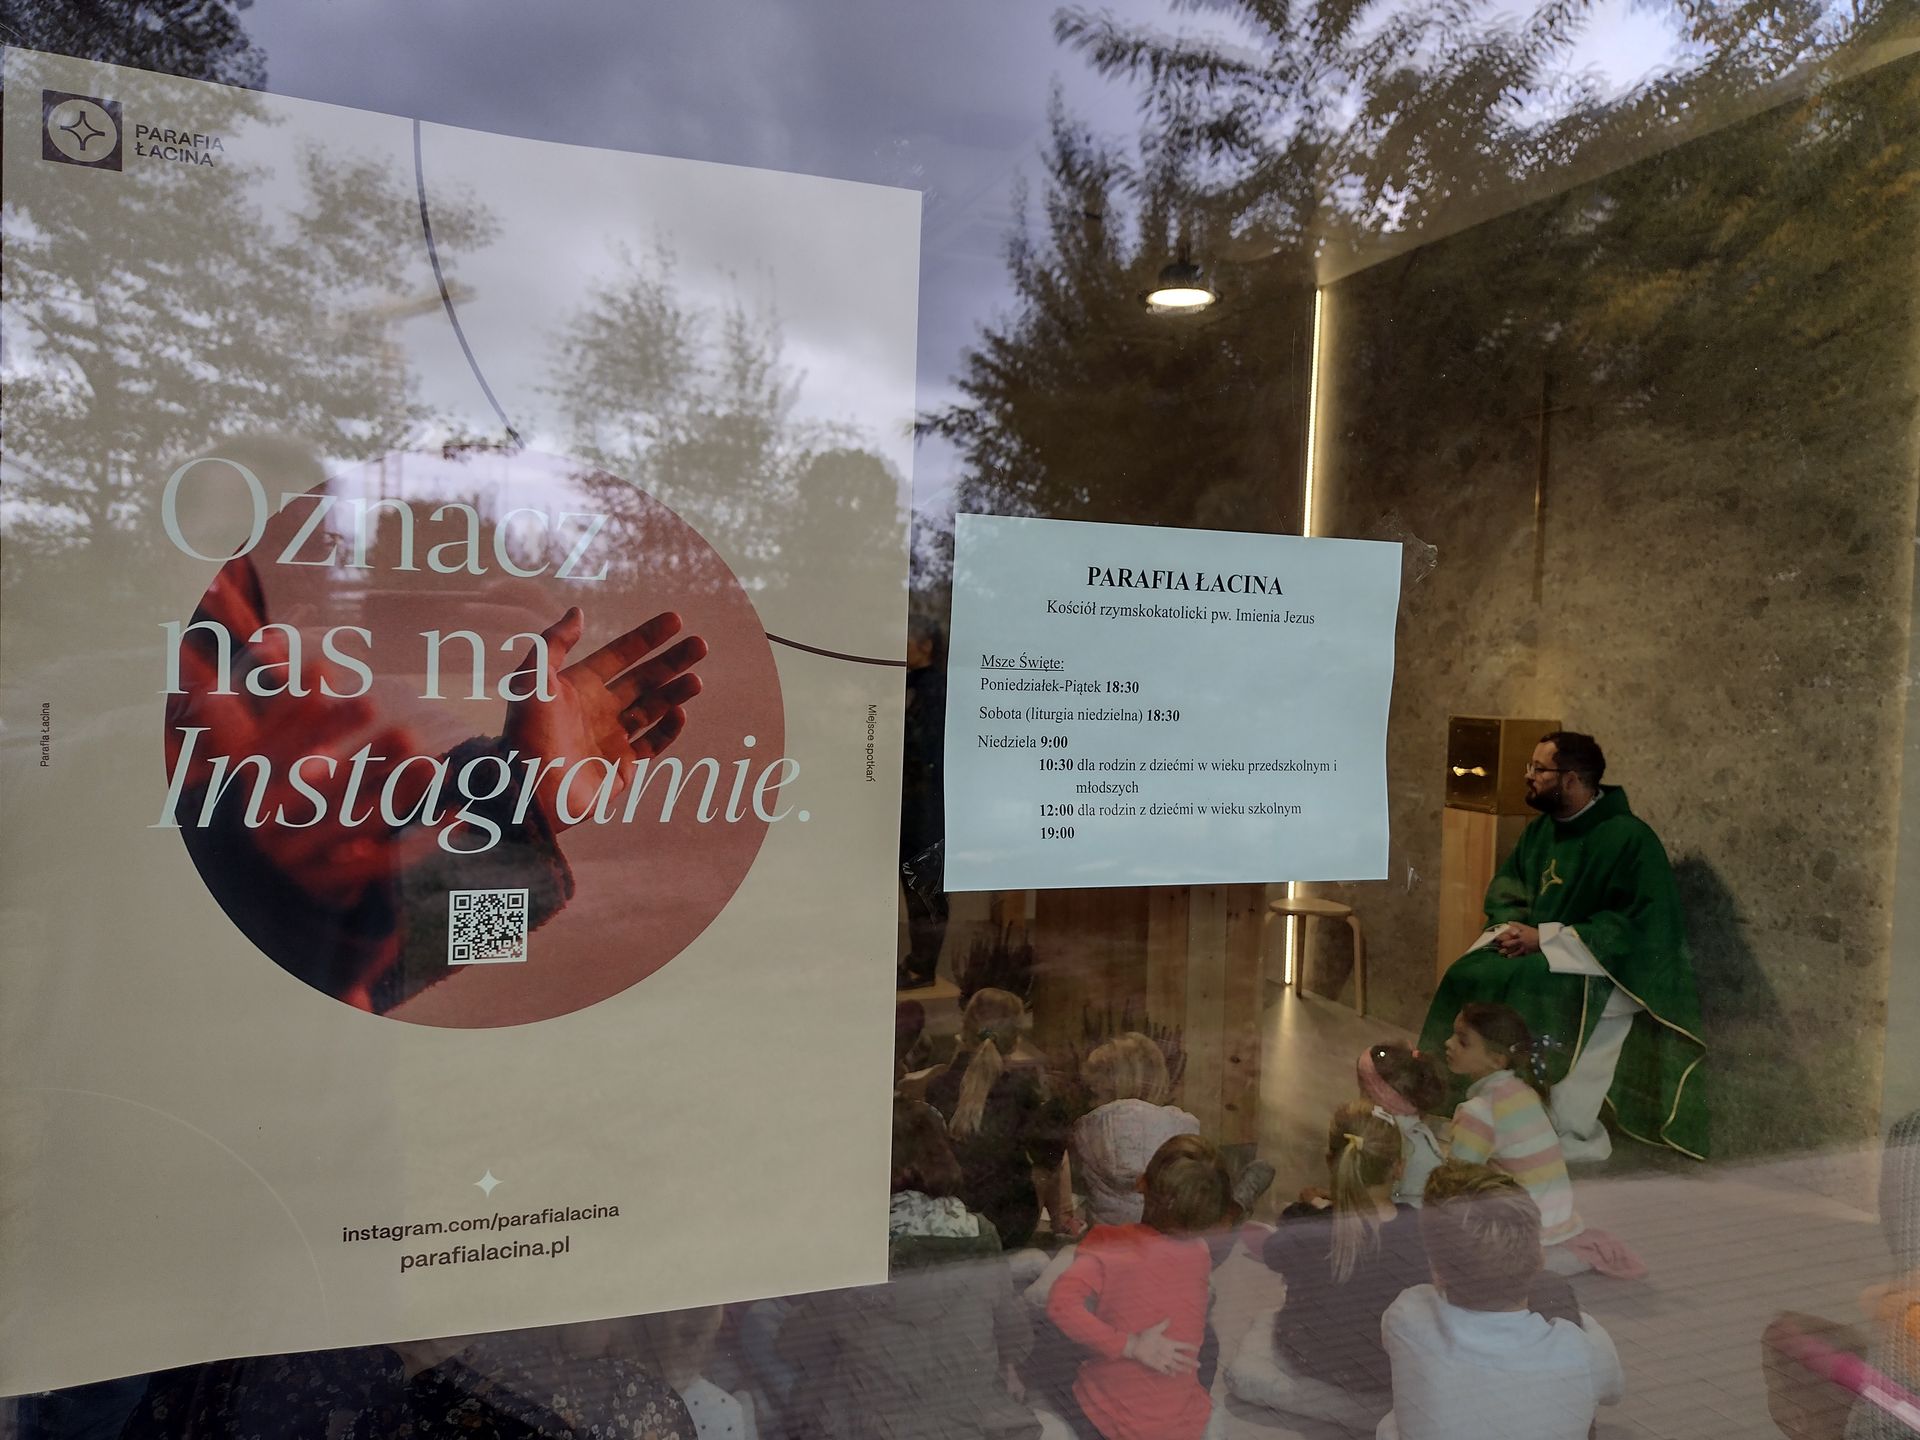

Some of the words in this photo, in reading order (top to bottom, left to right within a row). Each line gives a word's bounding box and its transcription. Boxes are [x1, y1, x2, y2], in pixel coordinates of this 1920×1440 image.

[135, 124, 225, 152] PARAFIA
[134, 141, 214, 167] ŁACINA
[161, 456, 612, 582] Oznacz
[1086, 566, 1190, 591] PARAFIA
[1195, 572, 1283, 595] ŁACINA
[1047, 600, 1096, 615] Kościół
[1100, 604, 1207, 622] rzymskokatolicki
[1211, 611, 1231, 623] pw.
[1236, 609, 1282, 623] Imienia
[1284, 611, 1314, 624] Jezus
[157, 614, 374, 699] nas
[418, 628, 558, 703] na
[980, 652, 1017, 671] Msze
[1018, 652, 1064, 672] Święte:
[981, 677, 1103, 696] Poniedziałek-Piątek
[1105, 681, 1140, 693] 18:30
[40, 702, 50, 733] Łacina
[866, 704, 877, 741] Miejsce
[979, 705, 1021, 720] Sobota
[1025, 705, 1074, 724] (liturgia
[1078, 706, 1143, 725] niedzielna)
[1147, 709, 1180, 722] 18:30
[39, 734, 50, 767] Parafia
[976, 733, 1037, 751] Niedziela
[1041, 736, 1070, 750] 9:00
[865, 742, 876, 782] spotkań
[1040, 757, 1075, 771] 10:30
[1077, 756, 1095, 773] dla
[1099, 757, 1136, 774] rodzin
[1139, 761, 1147, 773] z
[1149, 757, 1196, 773] dziećmi
[1197, 762, 1209, 772] w
[1211, 759, 1245, 771] wieku
[1248, 759, 1329, 775] przedszkolnym
[147, 726, 812, 855] Instagramie.
[1076, 778, 1139, 796] młodszych
[1040, 801, 1073, 816] 12:00
[1078, 804, 1095, 816] dla
[1099, 803, 1136, 816] rodzin
[1139, 806, 1148, 816] z
[1150, 801, 1195, 815] dziećmi
[1196, 805, 1208, 815] w
[1211, 802, 1244, 814] wieku
[1248, 802, 1301, 817] szkolnym
[1041, 827, 1074, 840] 19:00
[342, 1203, 620, 1242] instagram.com/parafialacina
[400, 1235, 570, 1273] parafialacina.pl
